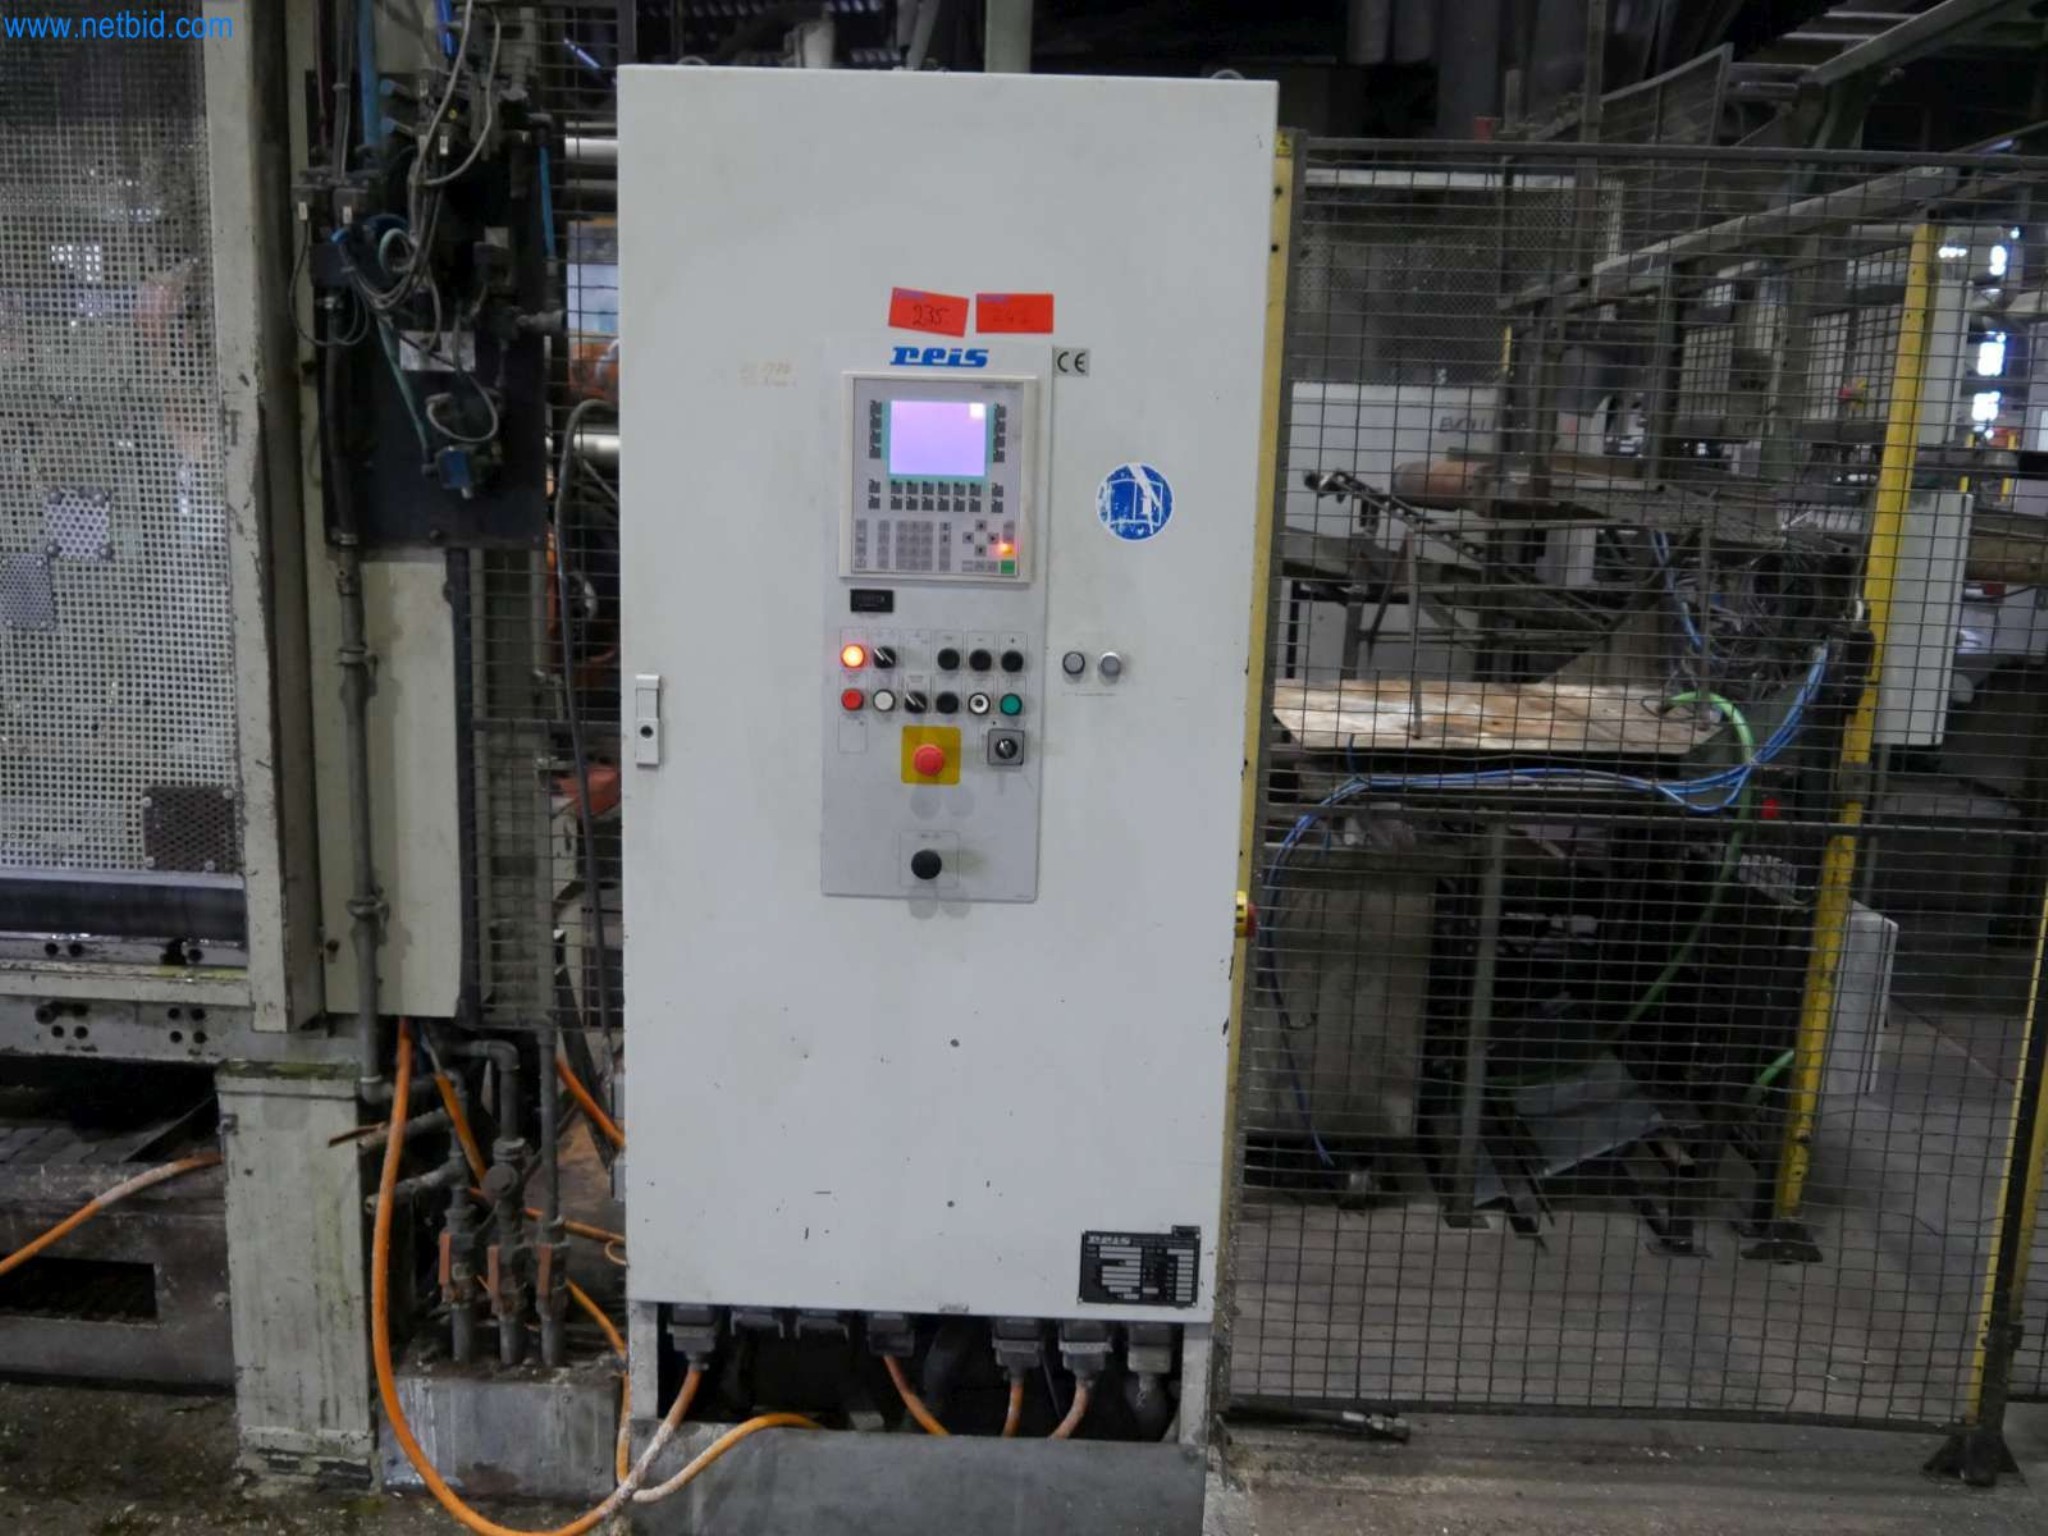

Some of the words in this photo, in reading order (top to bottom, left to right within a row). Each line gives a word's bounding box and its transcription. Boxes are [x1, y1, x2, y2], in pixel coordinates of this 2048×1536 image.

[912, 304, 949, 326] 235
[889, 346, 989, 367] reis
[1057, 351, 1086, 373] CE
